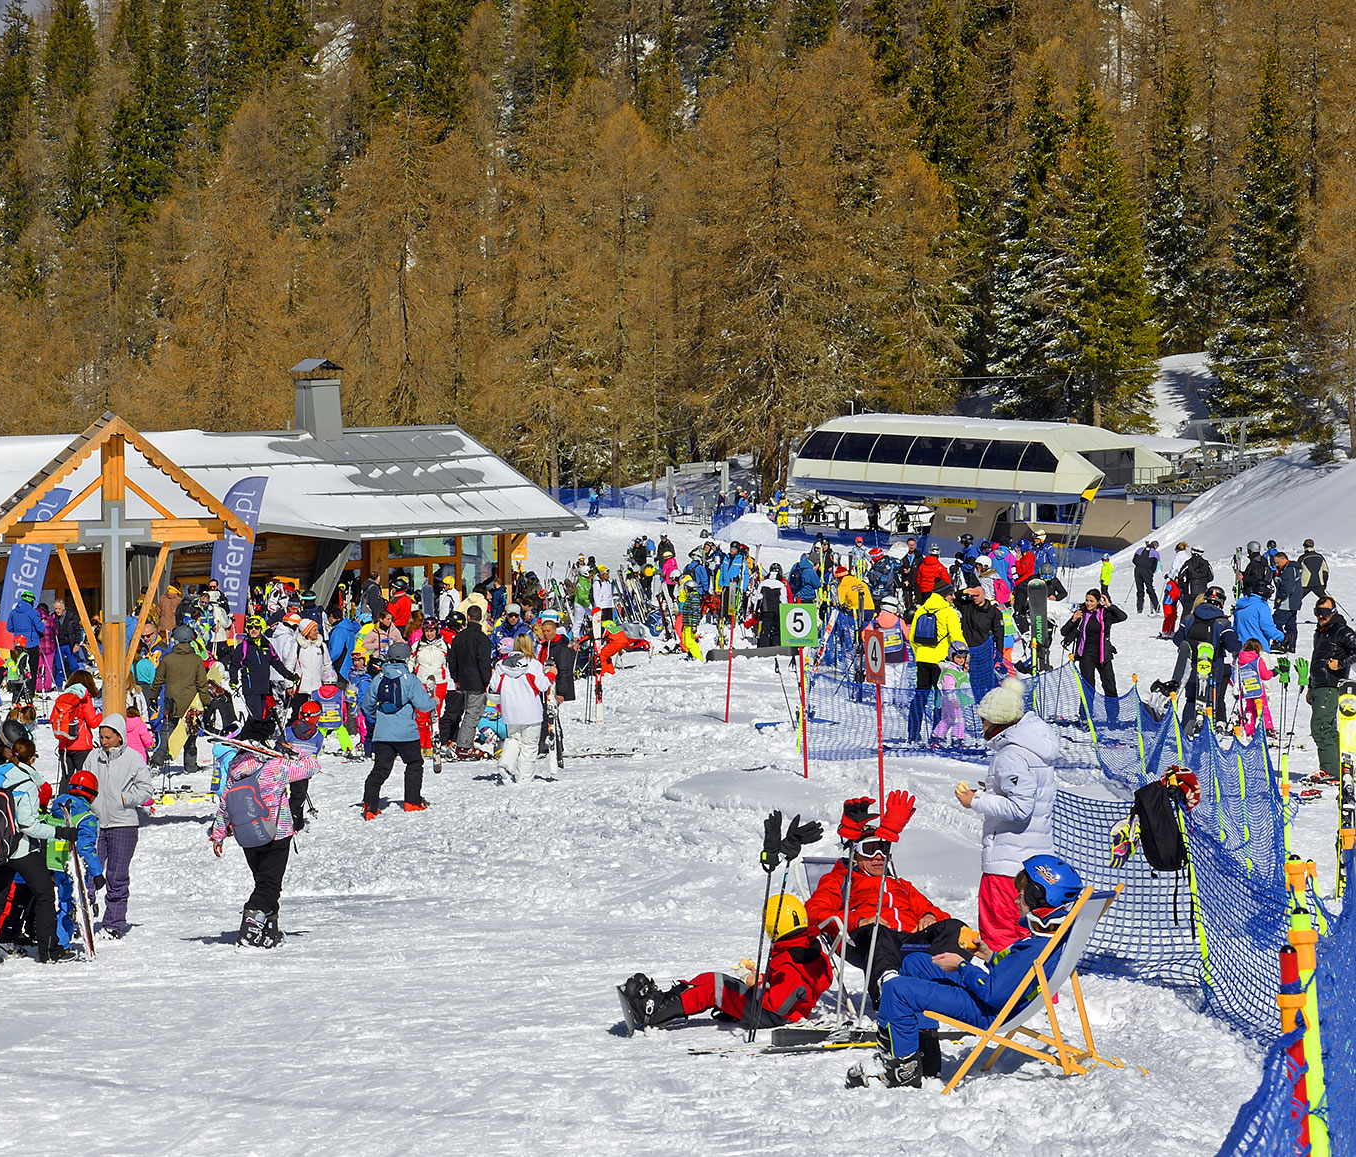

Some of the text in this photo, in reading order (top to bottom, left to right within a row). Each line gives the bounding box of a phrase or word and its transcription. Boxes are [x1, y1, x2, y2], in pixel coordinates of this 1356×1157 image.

[12, 501, 59, 610] aferipl
[219, 490, 258, 607] naferi.pl
[793, 612, 804, 633] 5
[870, 641, 878, 667] 4
